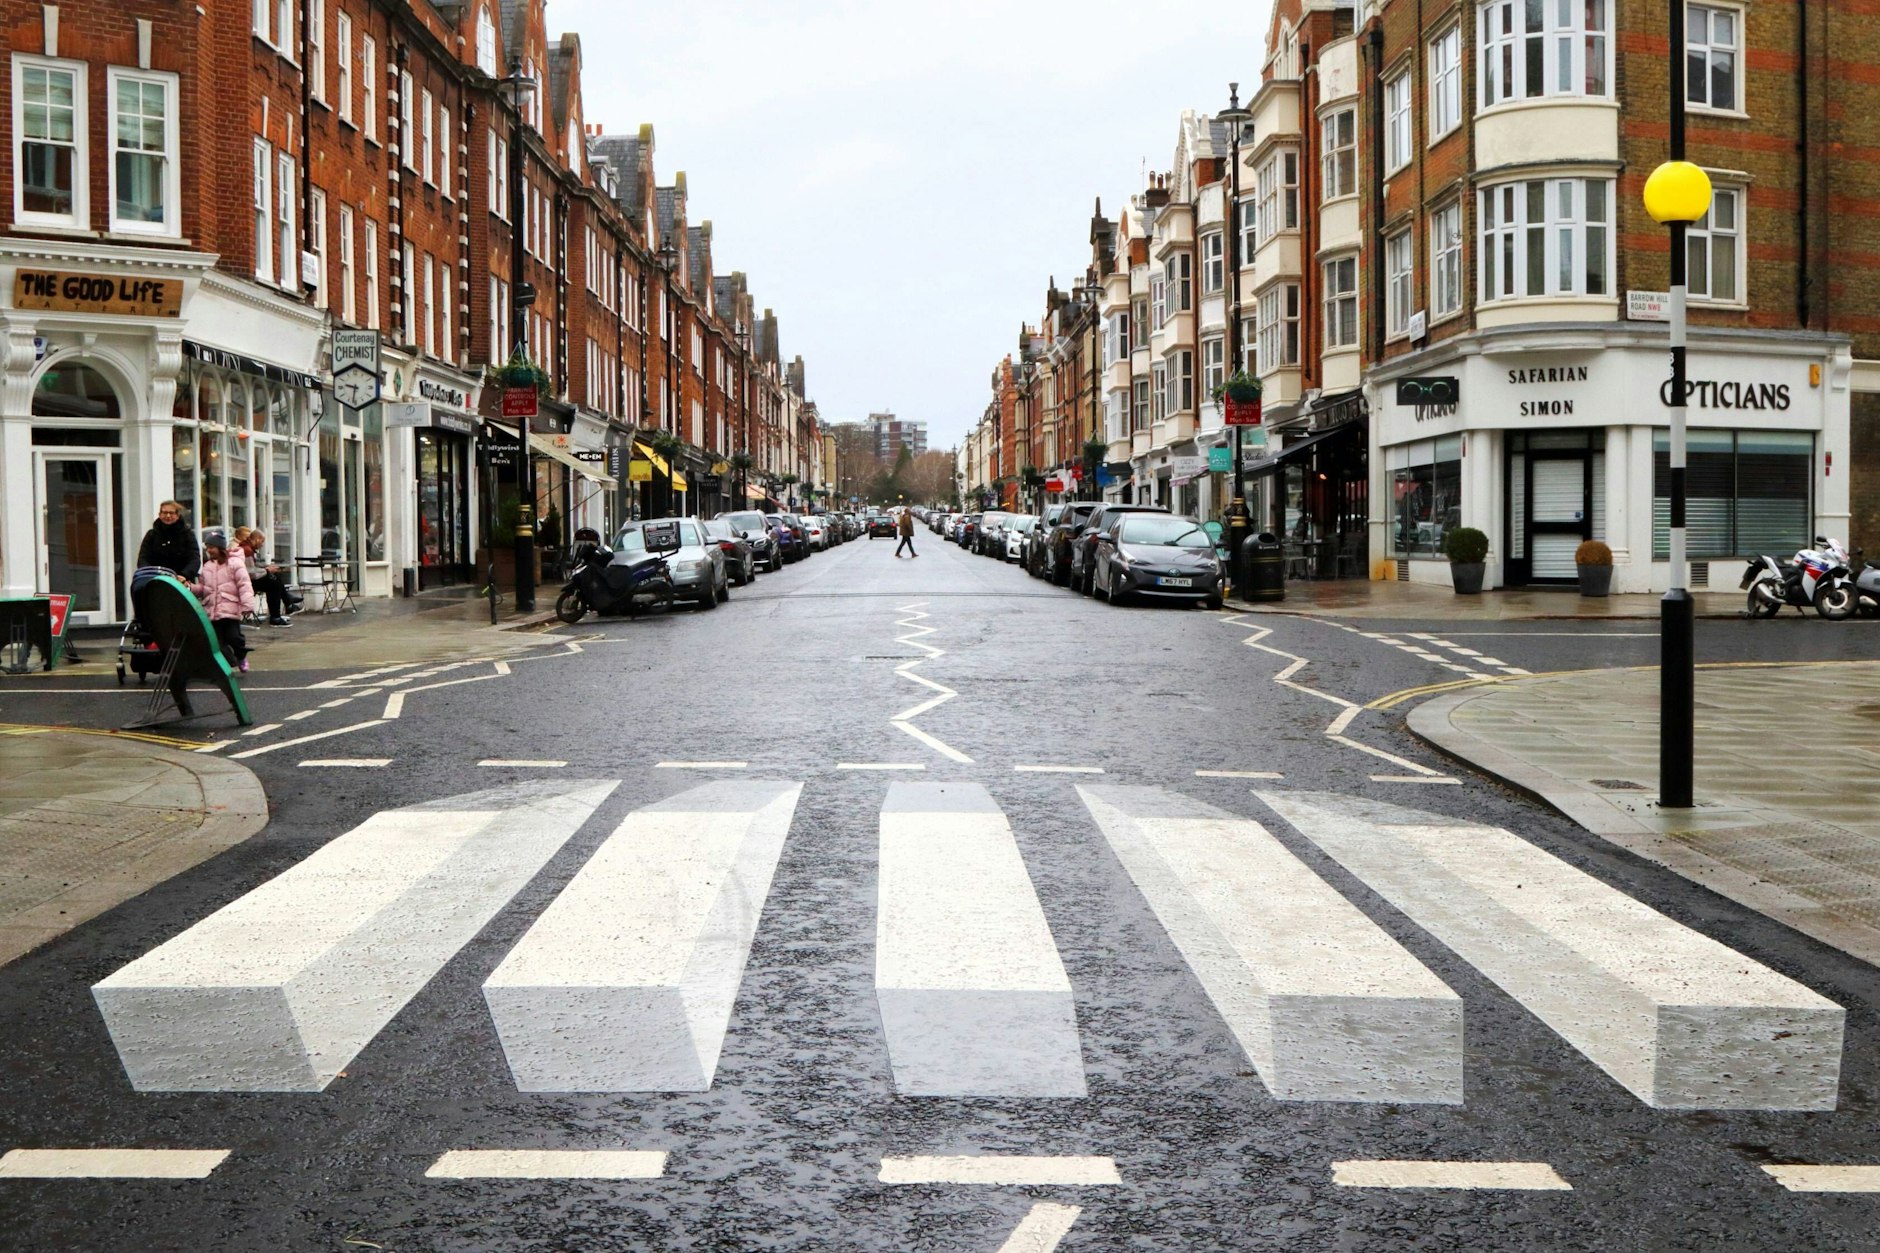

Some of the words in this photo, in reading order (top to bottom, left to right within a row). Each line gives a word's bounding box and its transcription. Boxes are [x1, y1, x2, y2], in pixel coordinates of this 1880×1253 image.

[20, 273, 57, 297] THE
[62, 276, 115, 302] GOOD
[1630, 293, 1655, 302] BARROW
[1656, 294, 1669, 303] HILL
[18, 300, 162, 316] EATERY
[1630, 302, 1647, 311] ROAD
[1647, 302, 1661, 311] NW8
[335, 331, 375, 345] Courtenay
[335, 345, 375, 362] CHEMIST
[1508, 366, 1588, 384] SAFARIAN
[504, 392, 536, 400] CONTROLS
[1520, 399, 1574, 417] SIMON
